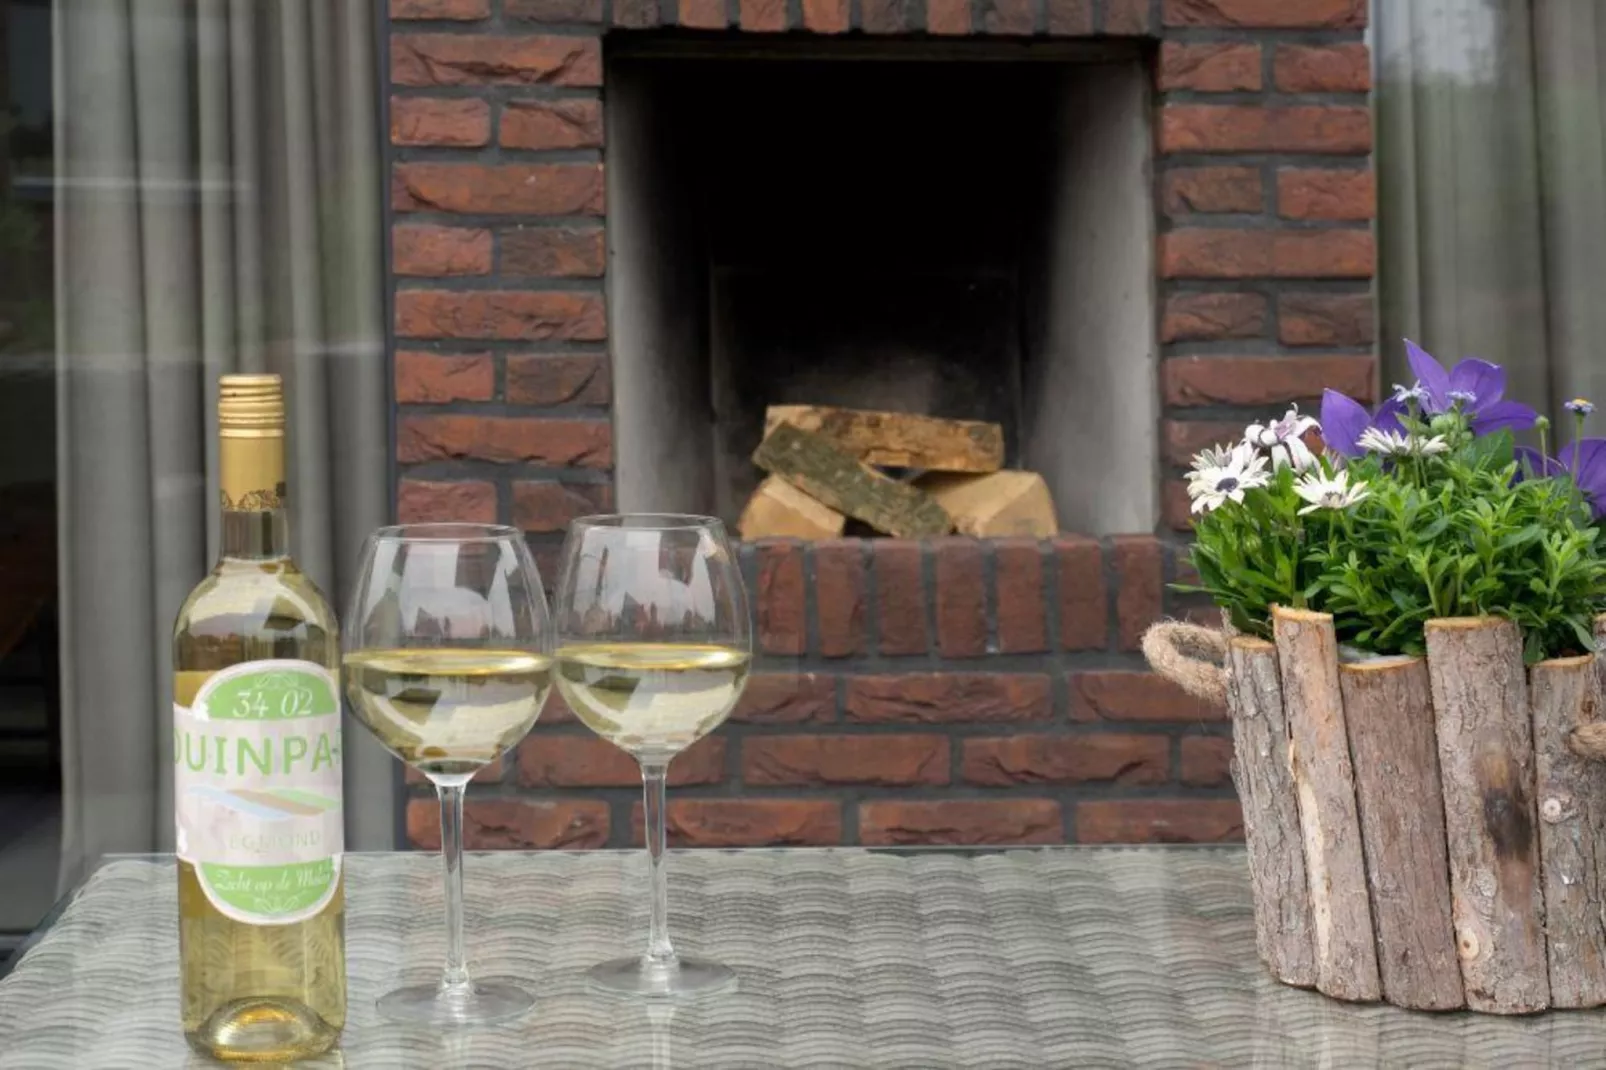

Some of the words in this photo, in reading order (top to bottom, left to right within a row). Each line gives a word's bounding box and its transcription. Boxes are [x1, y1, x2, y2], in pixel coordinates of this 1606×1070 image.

[232, 688, 269, 717] 34
[280, 689, 313, 716] 02
[229, 829, 321, 850] EGMOND
